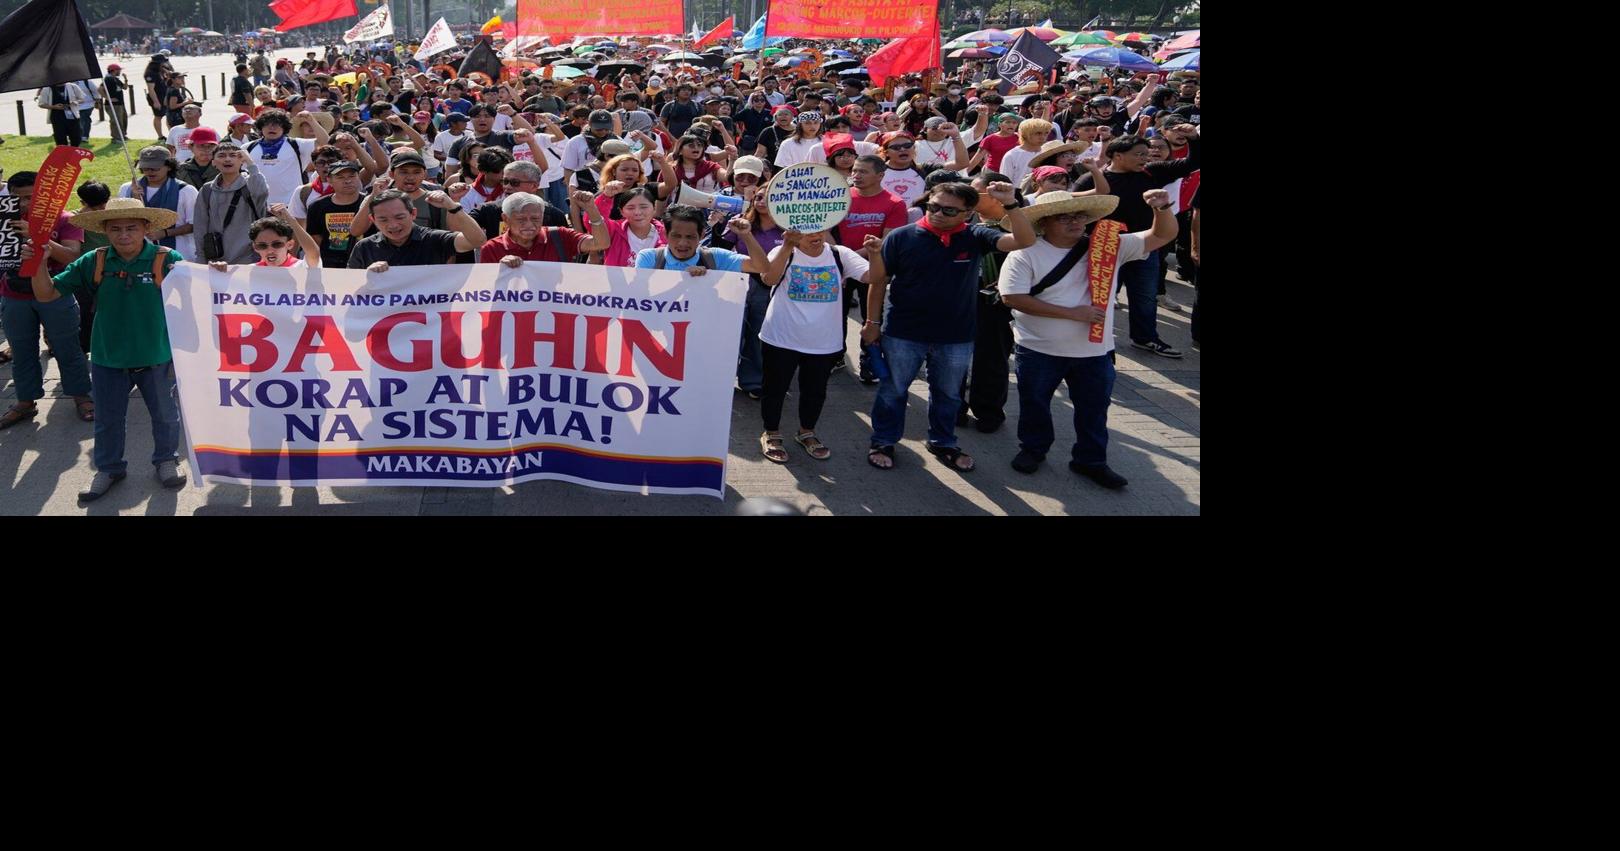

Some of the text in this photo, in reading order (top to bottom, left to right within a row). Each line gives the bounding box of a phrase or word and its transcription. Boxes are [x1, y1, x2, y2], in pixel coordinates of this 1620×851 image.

[785, 166, 815, 179] LAHAT
[786, 177, 830, 191] SANGKOT,
[31, 164, 59, 219] PATALSIKIN!
[770, 187, 847, 203] DAPAT MANAGOT!
[776, 202, 847, 214] MARCOS-DUTERTE
[789, 213, 827, 226] RESIGN!
[847, 213, 886, 225] upreme
[1100, 264, 1113, 305] COUNCIL
[213, 290, 689, 313] IPAGLABAN ANG PAMBANSANG DEMOKRASYA!
[214, 311, 692, 382] BAGUHIN
[218, 373, 683, 416] KORAP AT BULOK
[283, 406, 613, 445] NA SISTEMA!
[366, 451, 543, 475] MAKABAYAN
